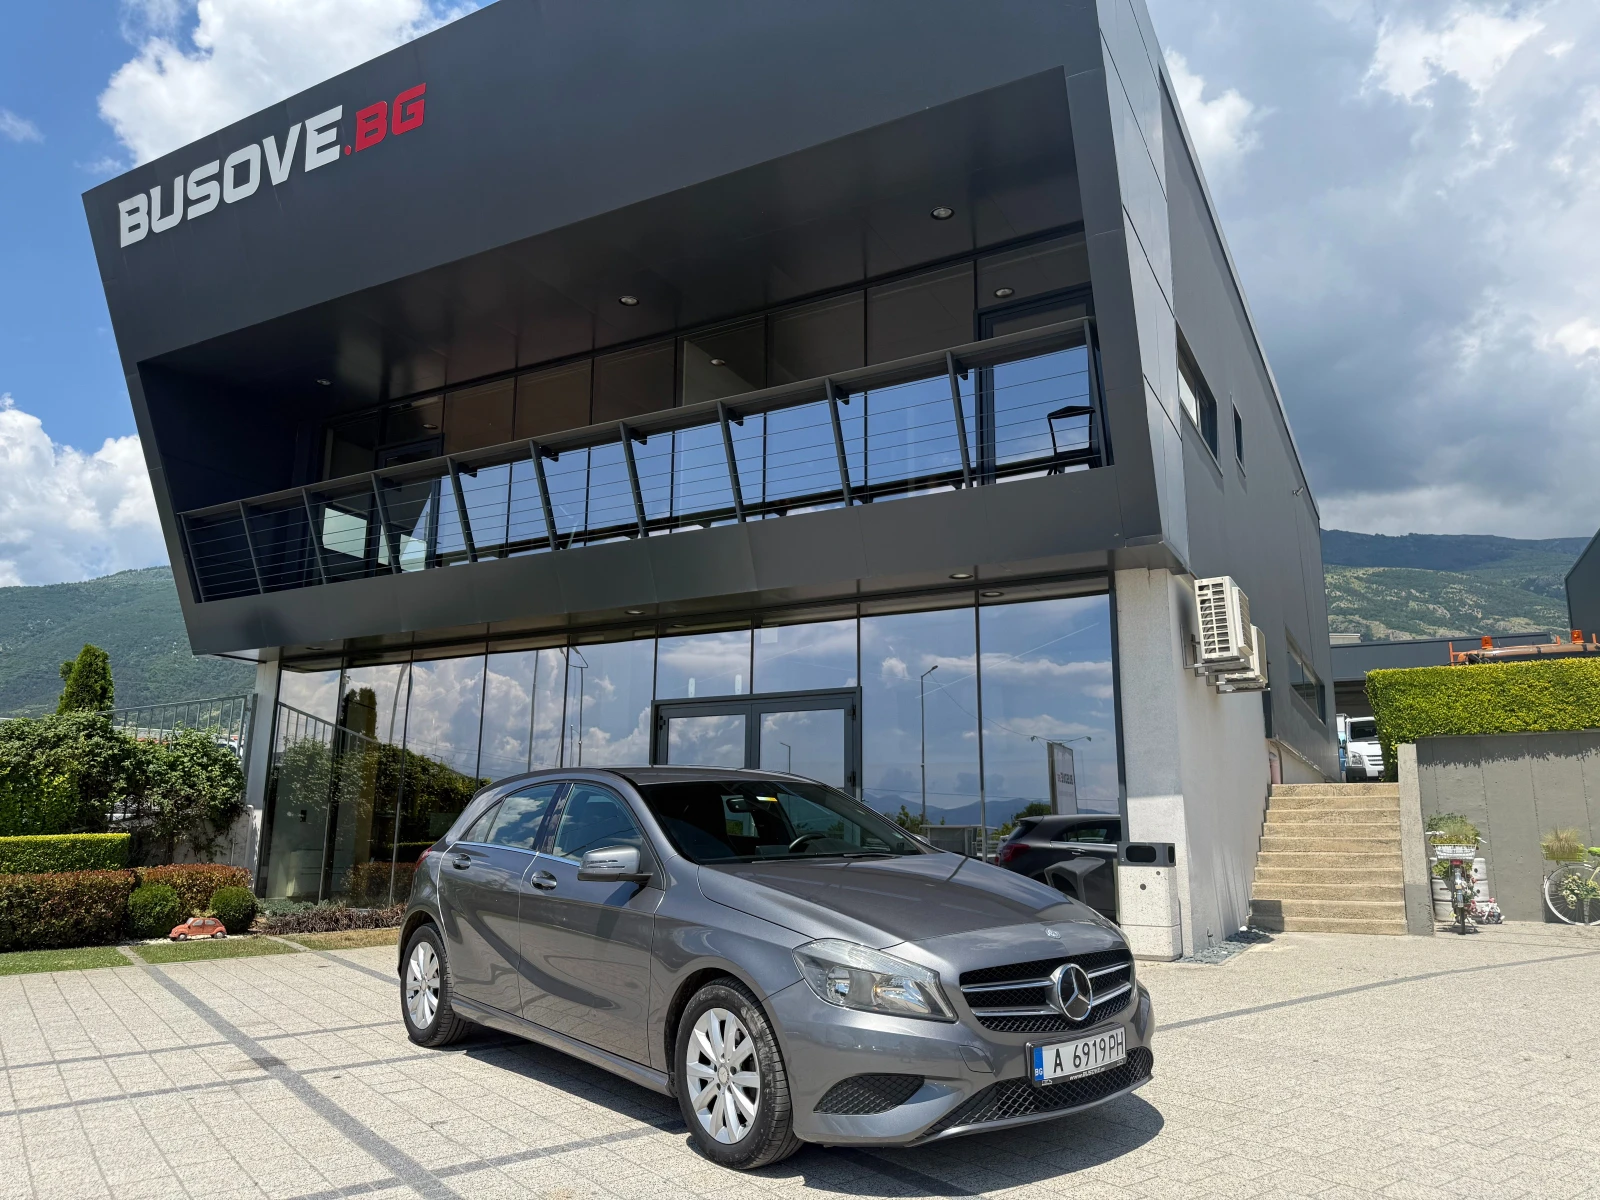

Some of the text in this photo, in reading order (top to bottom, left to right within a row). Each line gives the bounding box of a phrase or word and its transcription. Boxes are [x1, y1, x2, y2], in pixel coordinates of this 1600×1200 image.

[118, 82, 427, 248] BUSOVE.BG
[1034, 1068, 1043, 1076] BG
[1053, 1048, 1064, 1073] A
